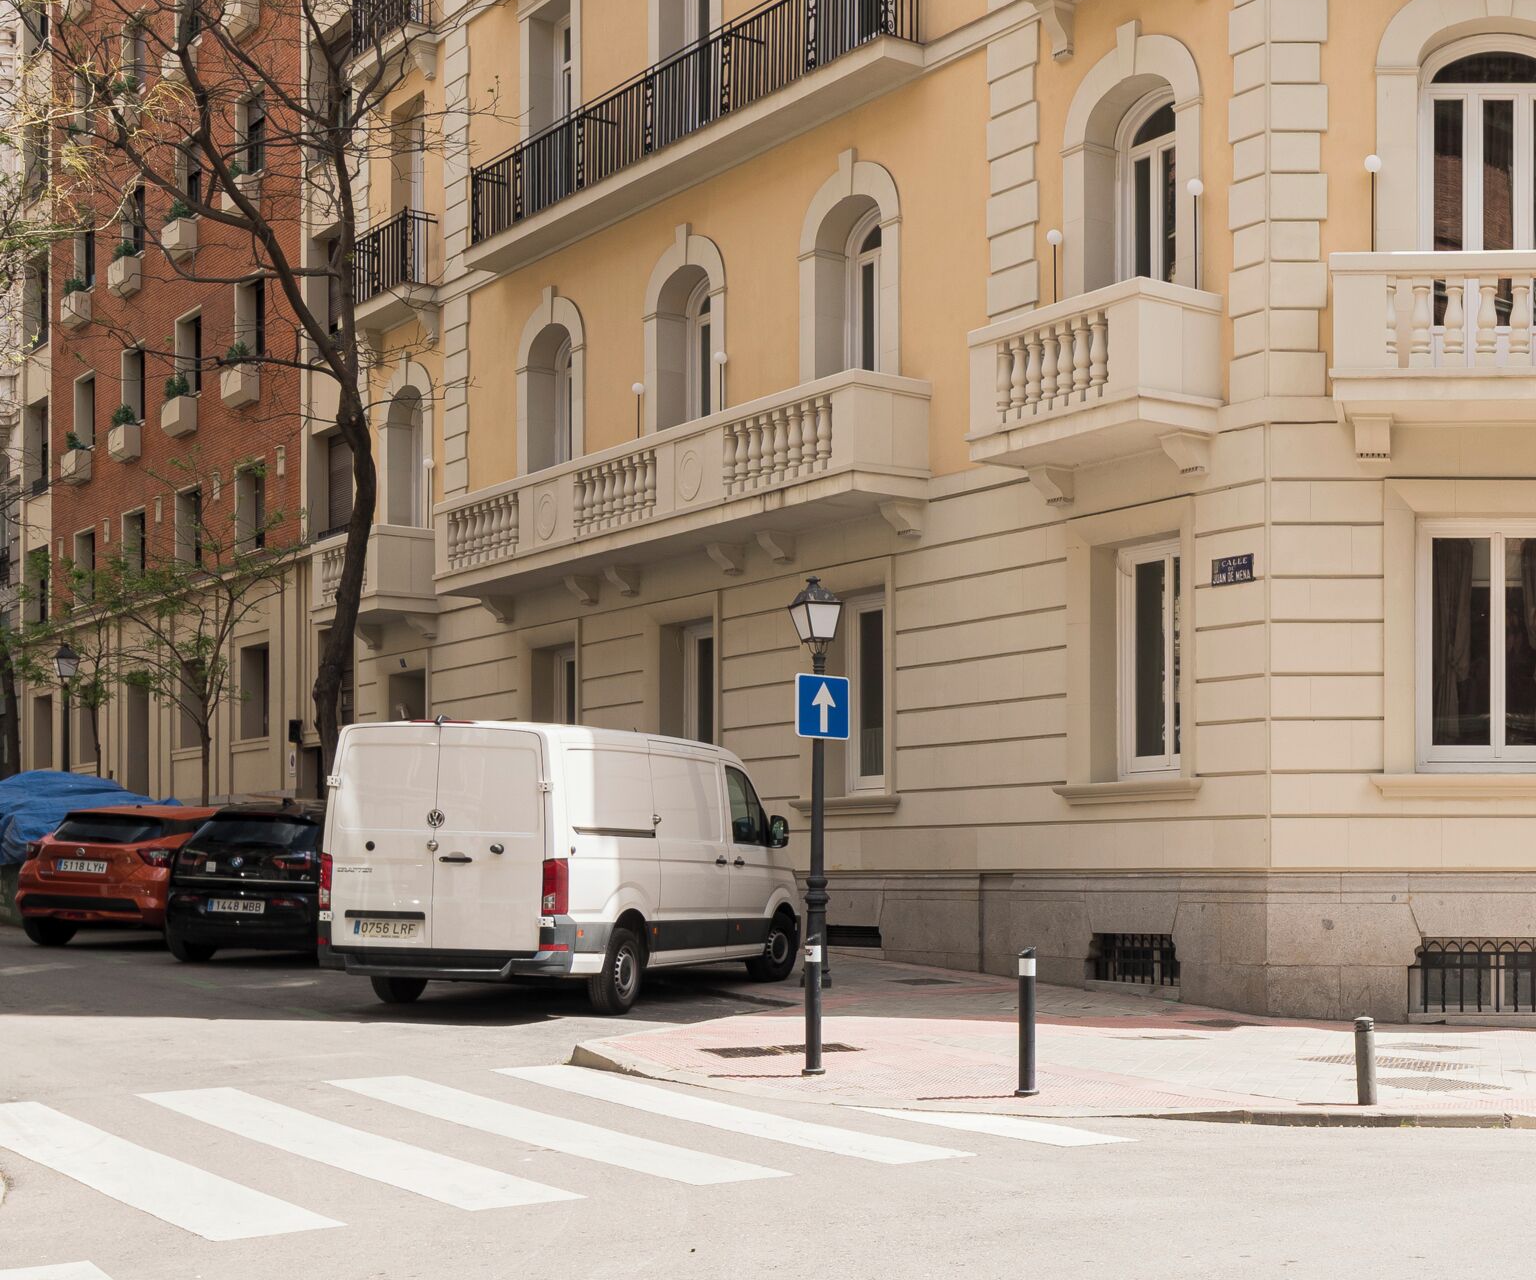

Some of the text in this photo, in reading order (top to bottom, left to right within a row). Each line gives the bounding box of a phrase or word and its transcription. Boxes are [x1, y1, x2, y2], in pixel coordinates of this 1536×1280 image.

[1221, 557, 1248, 567] CALLE
[1212, 569, 1251, 584] JUAN DE MENA
[63, 861, 104, 872] 5118 LYH
[216, 901, 261, 912] 1448 MBB
[361, 922, 416, 934] 0756 LRF
